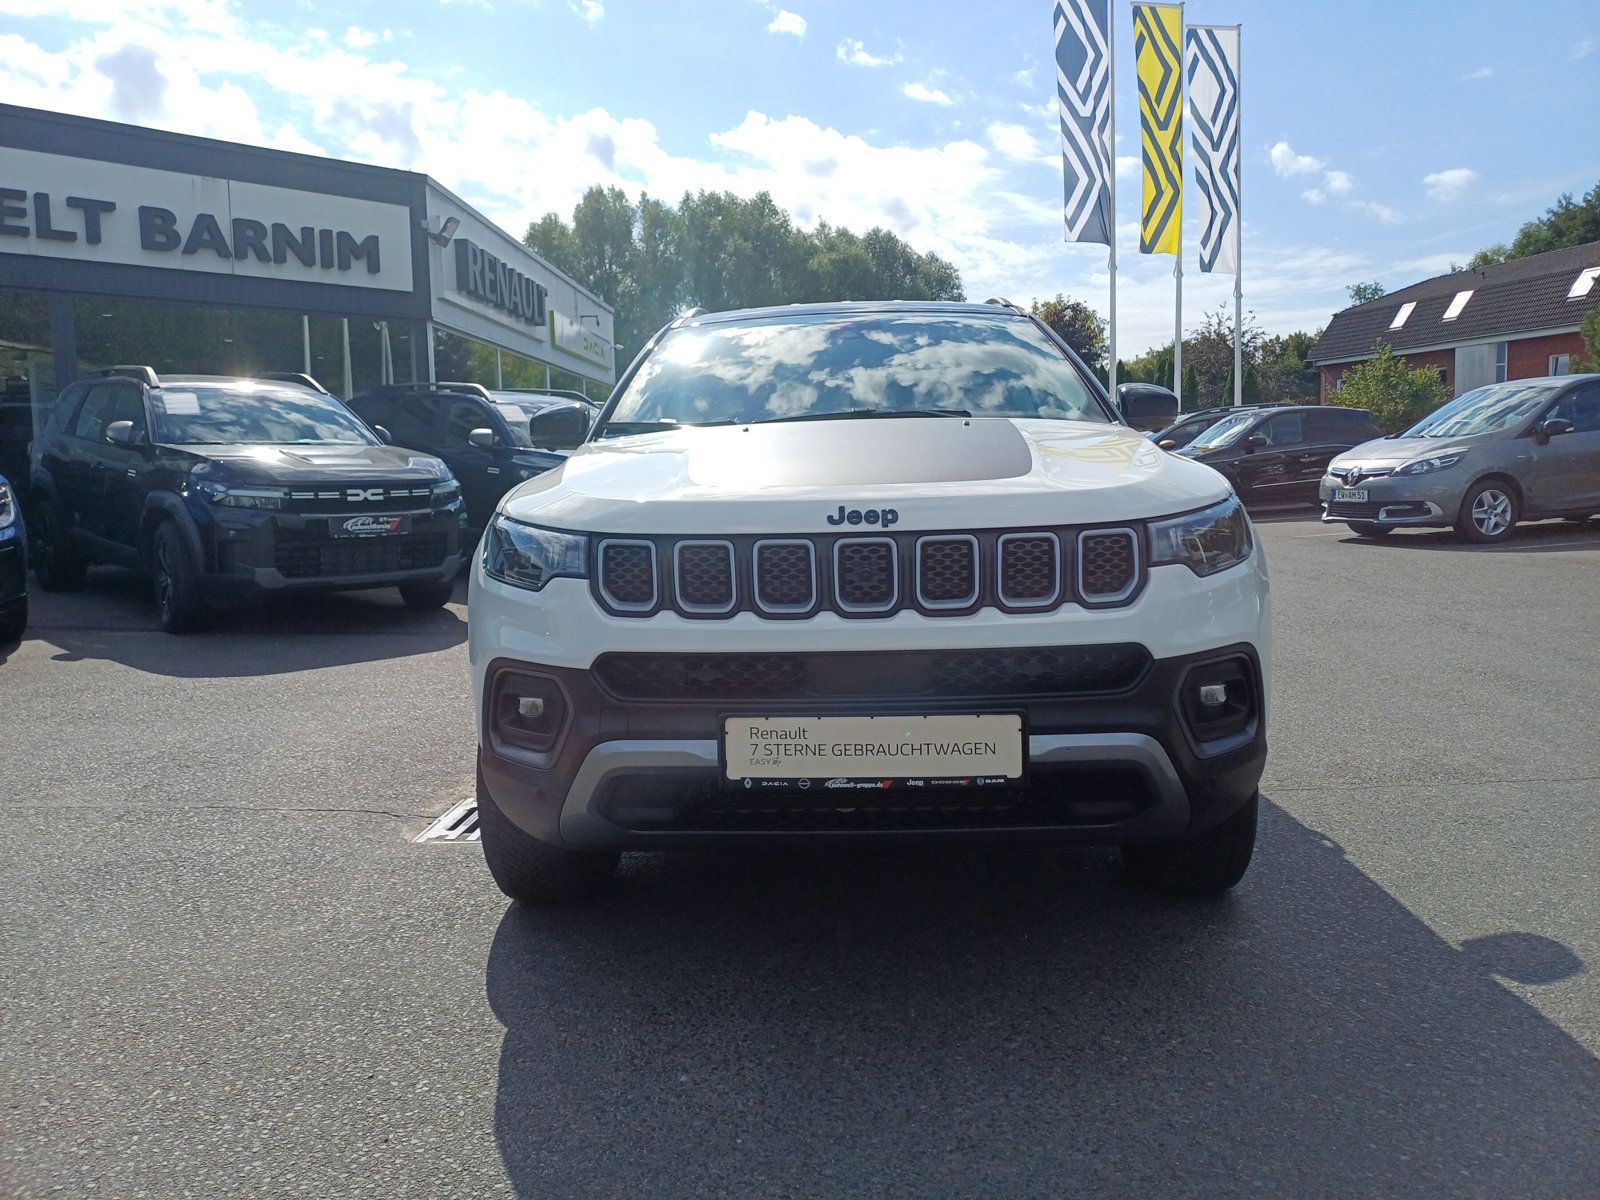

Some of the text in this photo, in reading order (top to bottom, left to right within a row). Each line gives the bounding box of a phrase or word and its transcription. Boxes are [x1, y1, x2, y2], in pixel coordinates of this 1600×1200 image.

[0, 188, 381, 275] ELT BARNIM
[456, 239, 548, 326] RENAULT
[826, 505, 899, 528] Jeep
[749, 726, 808, 740] Renault
[750, 742, 996, 757] 7 STERNE GEBRAUCHTWAGEN
[749, 758, 771, 766] EASY
[906, 778, 924, 787] Jeep
